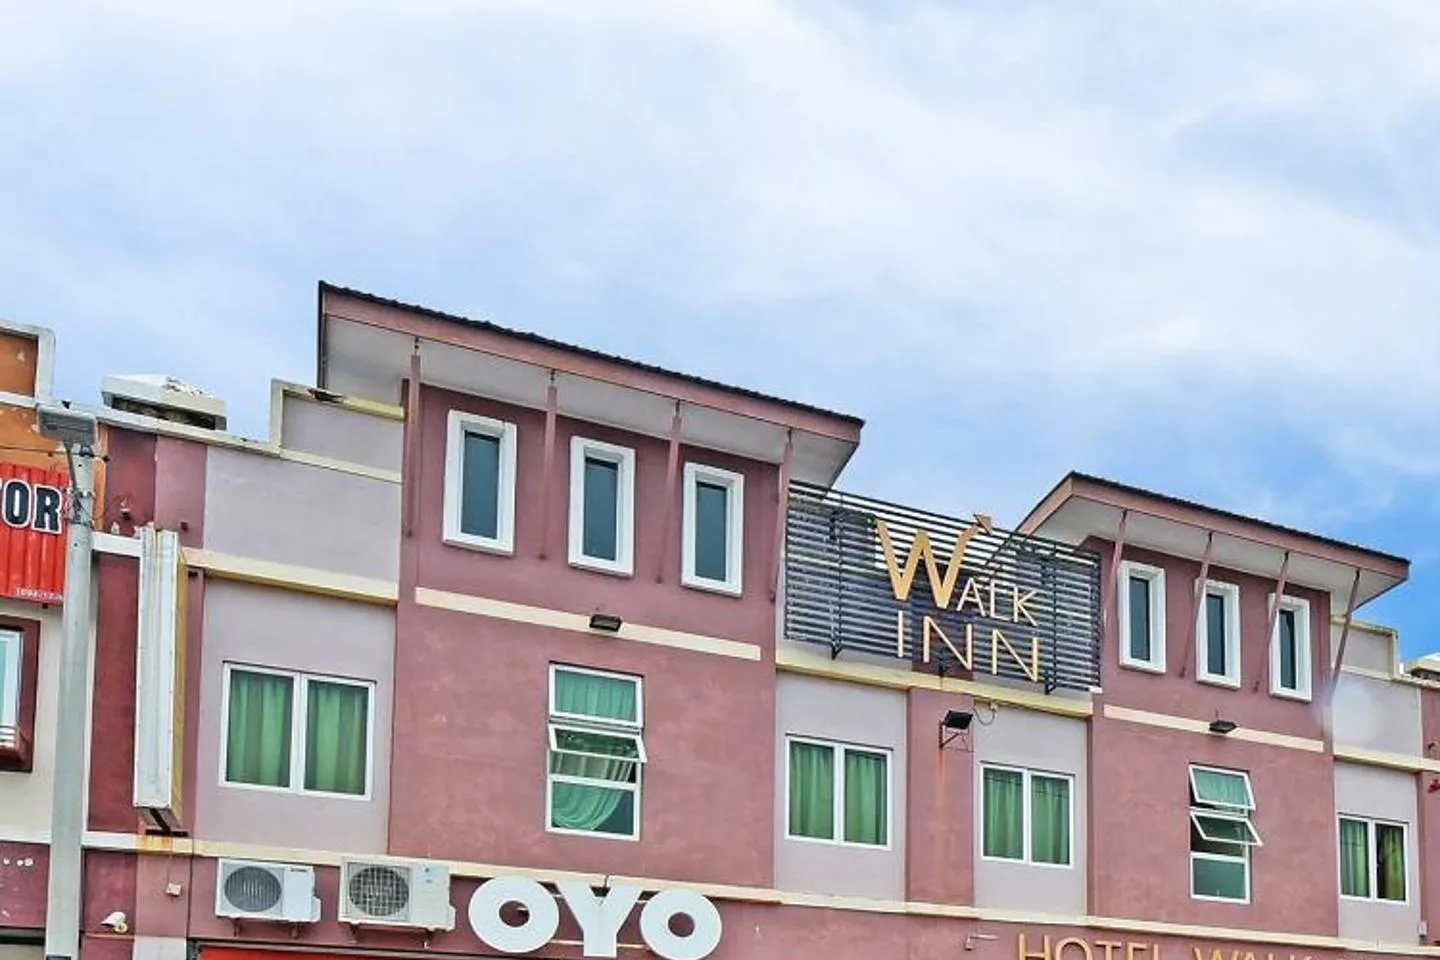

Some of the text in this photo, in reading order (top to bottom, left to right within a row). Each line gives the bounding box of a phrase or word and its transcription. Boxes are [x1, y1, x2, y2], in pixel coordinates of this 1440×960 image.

[0, 479, 62, 534] OR
[876, 514, 1039, 627] WALK
[897, 611, 1039, 682] INN
